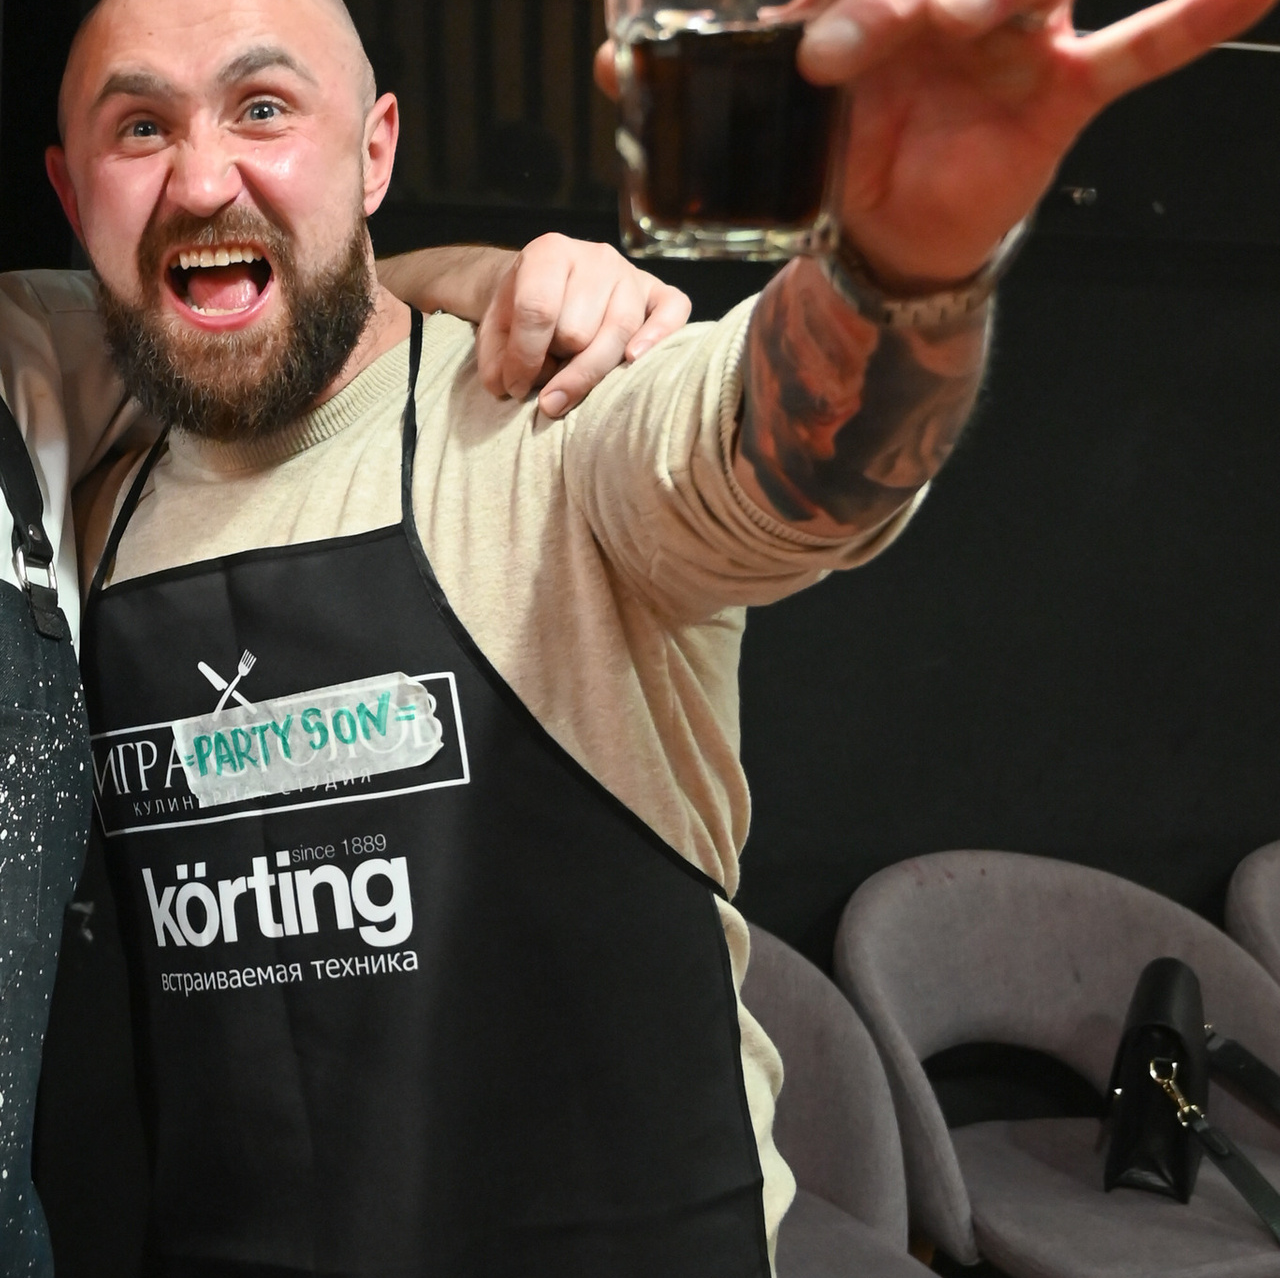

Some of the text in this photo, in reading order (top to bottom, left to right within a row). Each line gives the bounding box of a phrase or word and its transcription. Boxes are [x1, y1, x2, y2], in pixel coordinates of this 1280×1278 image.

[291, 833, 387, 863] since 1889
[141, 850, 414, 948] körting
[161, 950, 419, 997] встраиваемая техника
